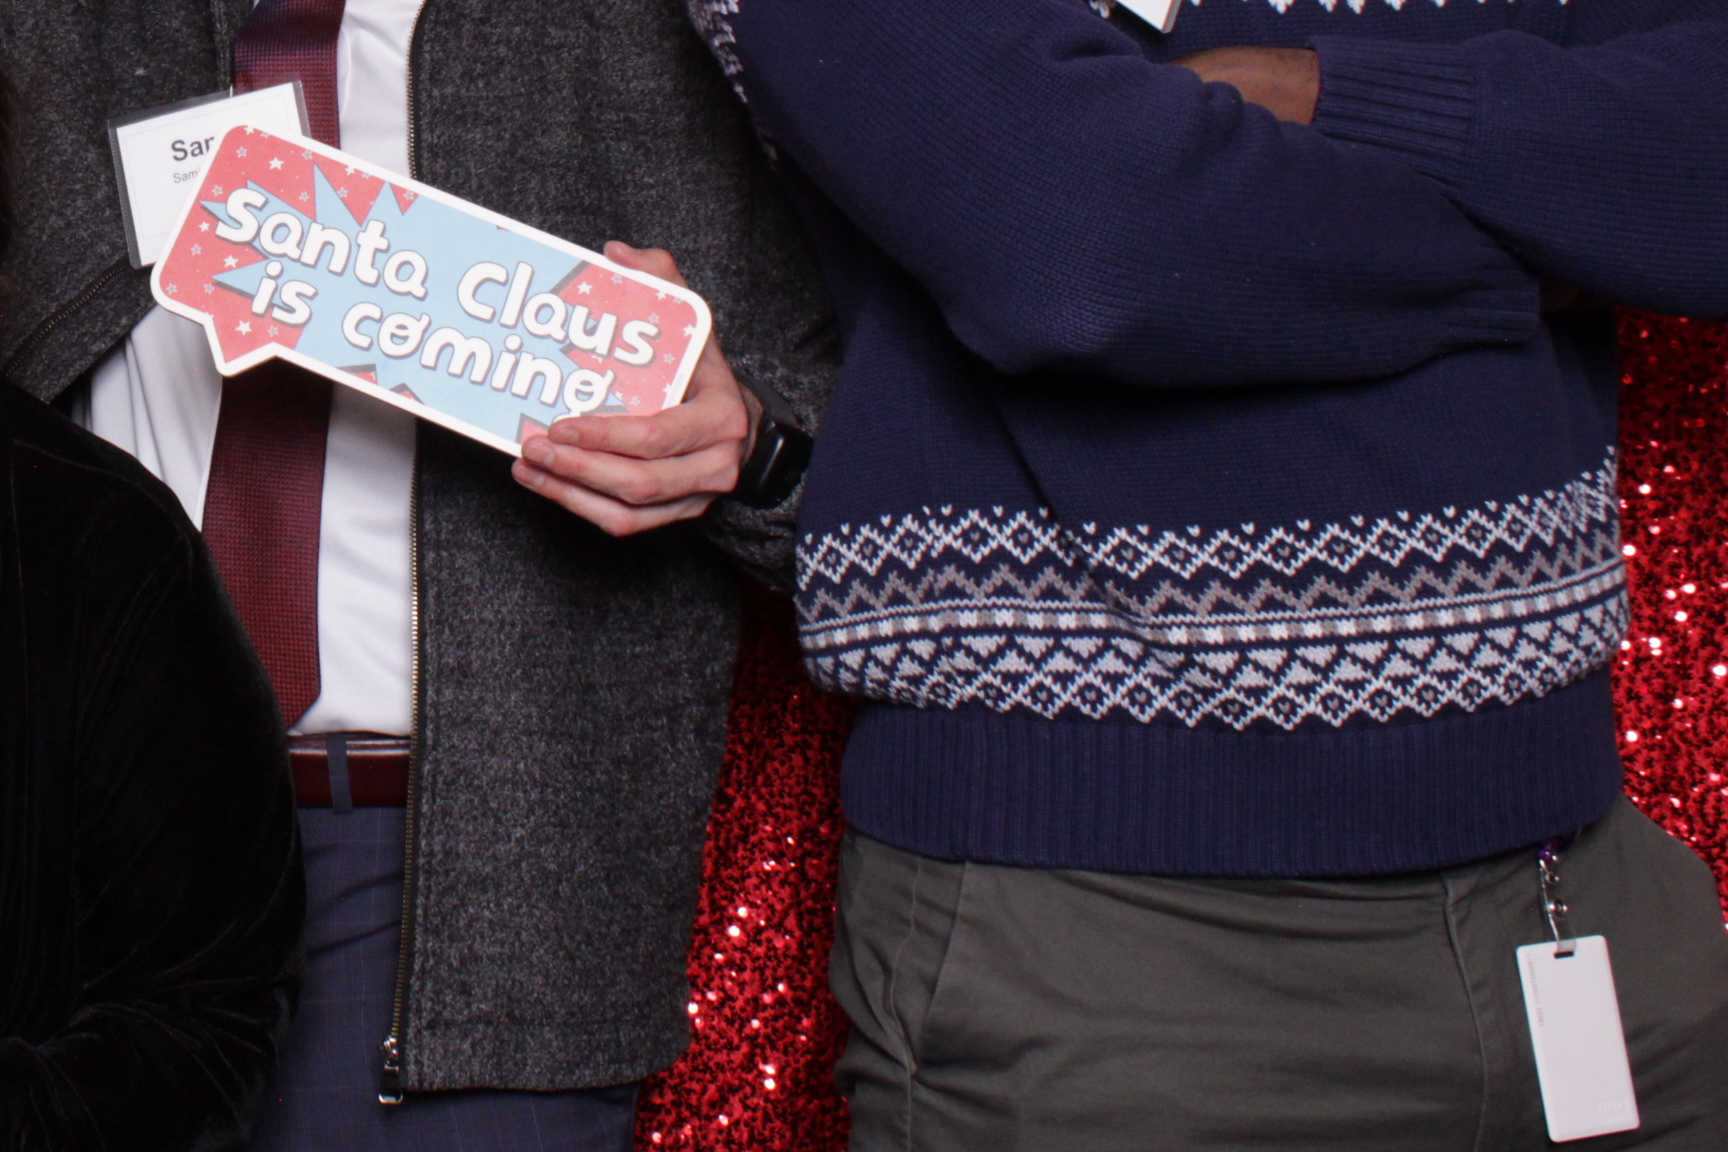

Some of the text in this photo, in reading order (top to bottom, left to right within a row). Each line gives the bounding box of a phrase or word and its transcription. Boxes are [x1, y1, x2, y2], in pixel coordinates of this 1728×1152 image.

[215, 186, 659, 366] Santa Claus
[251, 260, 615, 424] is coming
